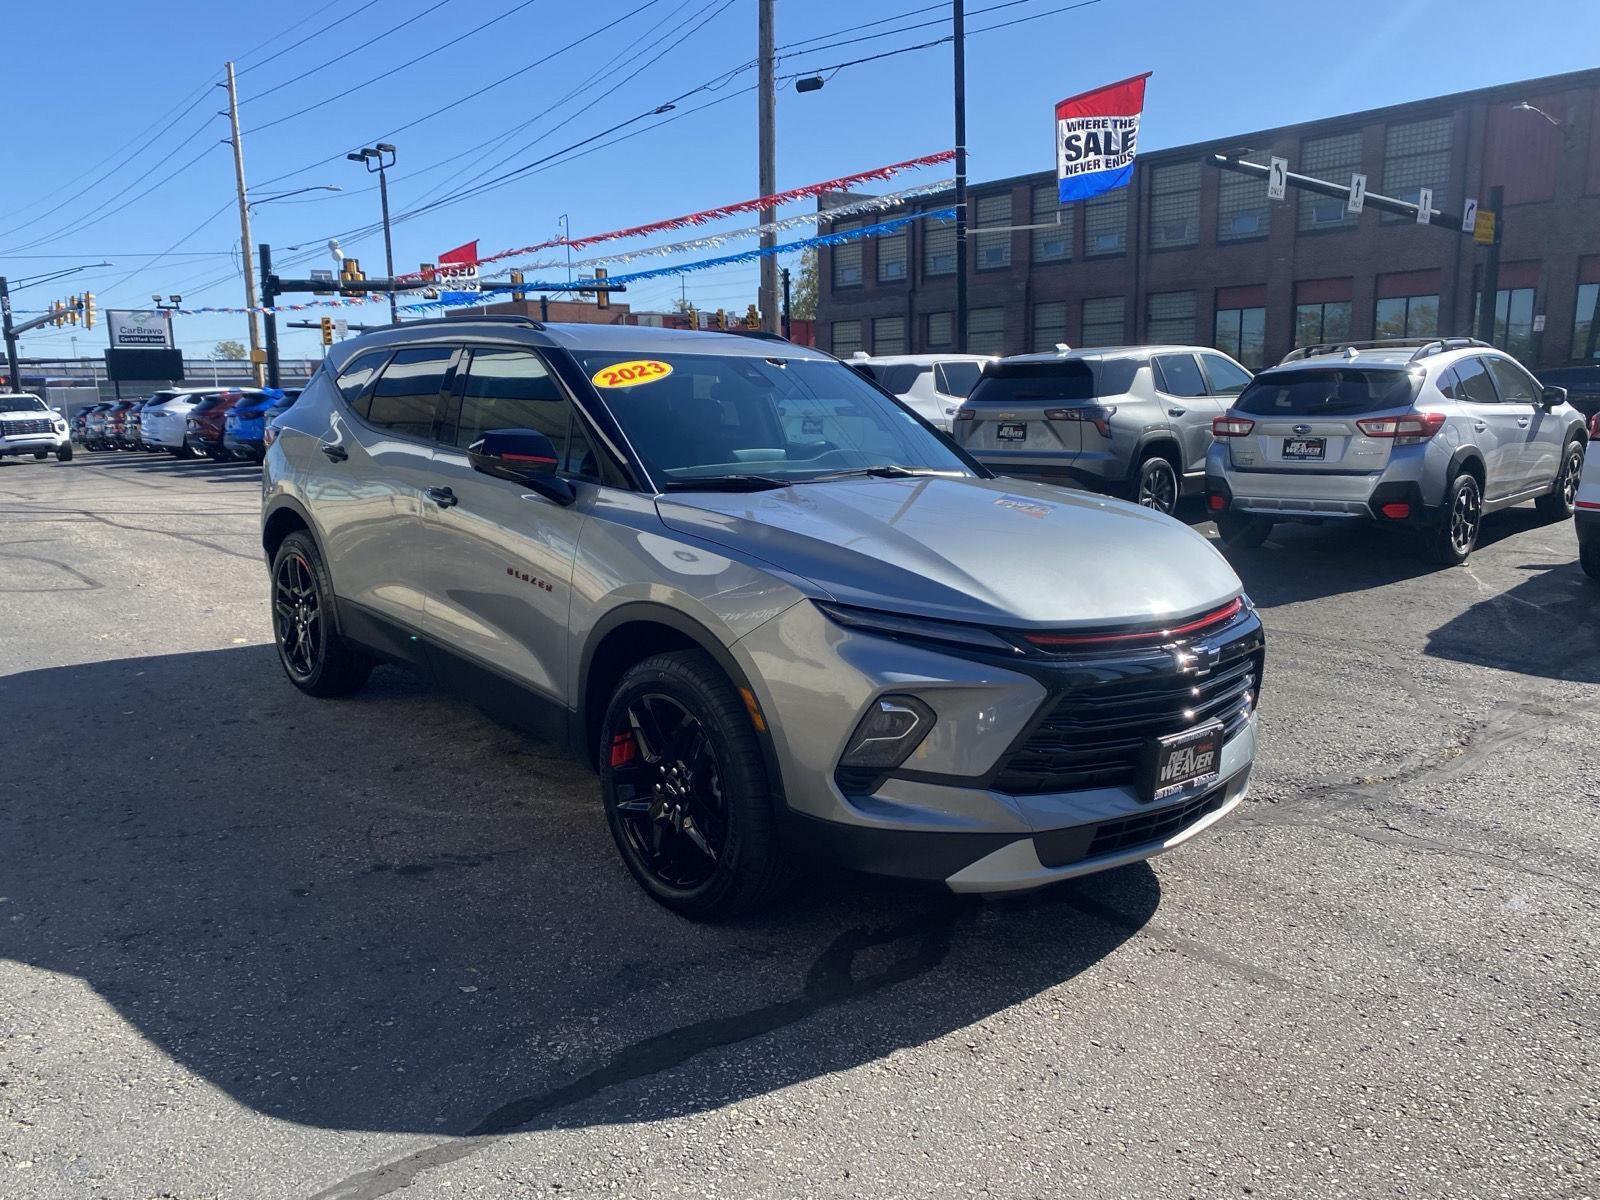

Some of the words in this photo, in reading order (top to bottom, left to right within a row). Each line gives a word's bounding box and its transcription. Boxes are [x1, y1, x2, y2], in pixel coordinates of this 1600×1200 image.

[1066, 119, 1108, 132] WHERE
[1113, 118, 1135, 129] THE
[1064, 127, 1136, 161] SALE
[1065, 161, 1101, 176] NEVER
[1105, 150, 1134, 169] ENDS
[120, 326, 163, 335] CarBravo
[602, 362, 667, 386] 2023
[506, 567, 553, 592] BLAZER
[1160, 751, 1214, 781] WEAVER
[1168, 745, 1196, 766] RICK
